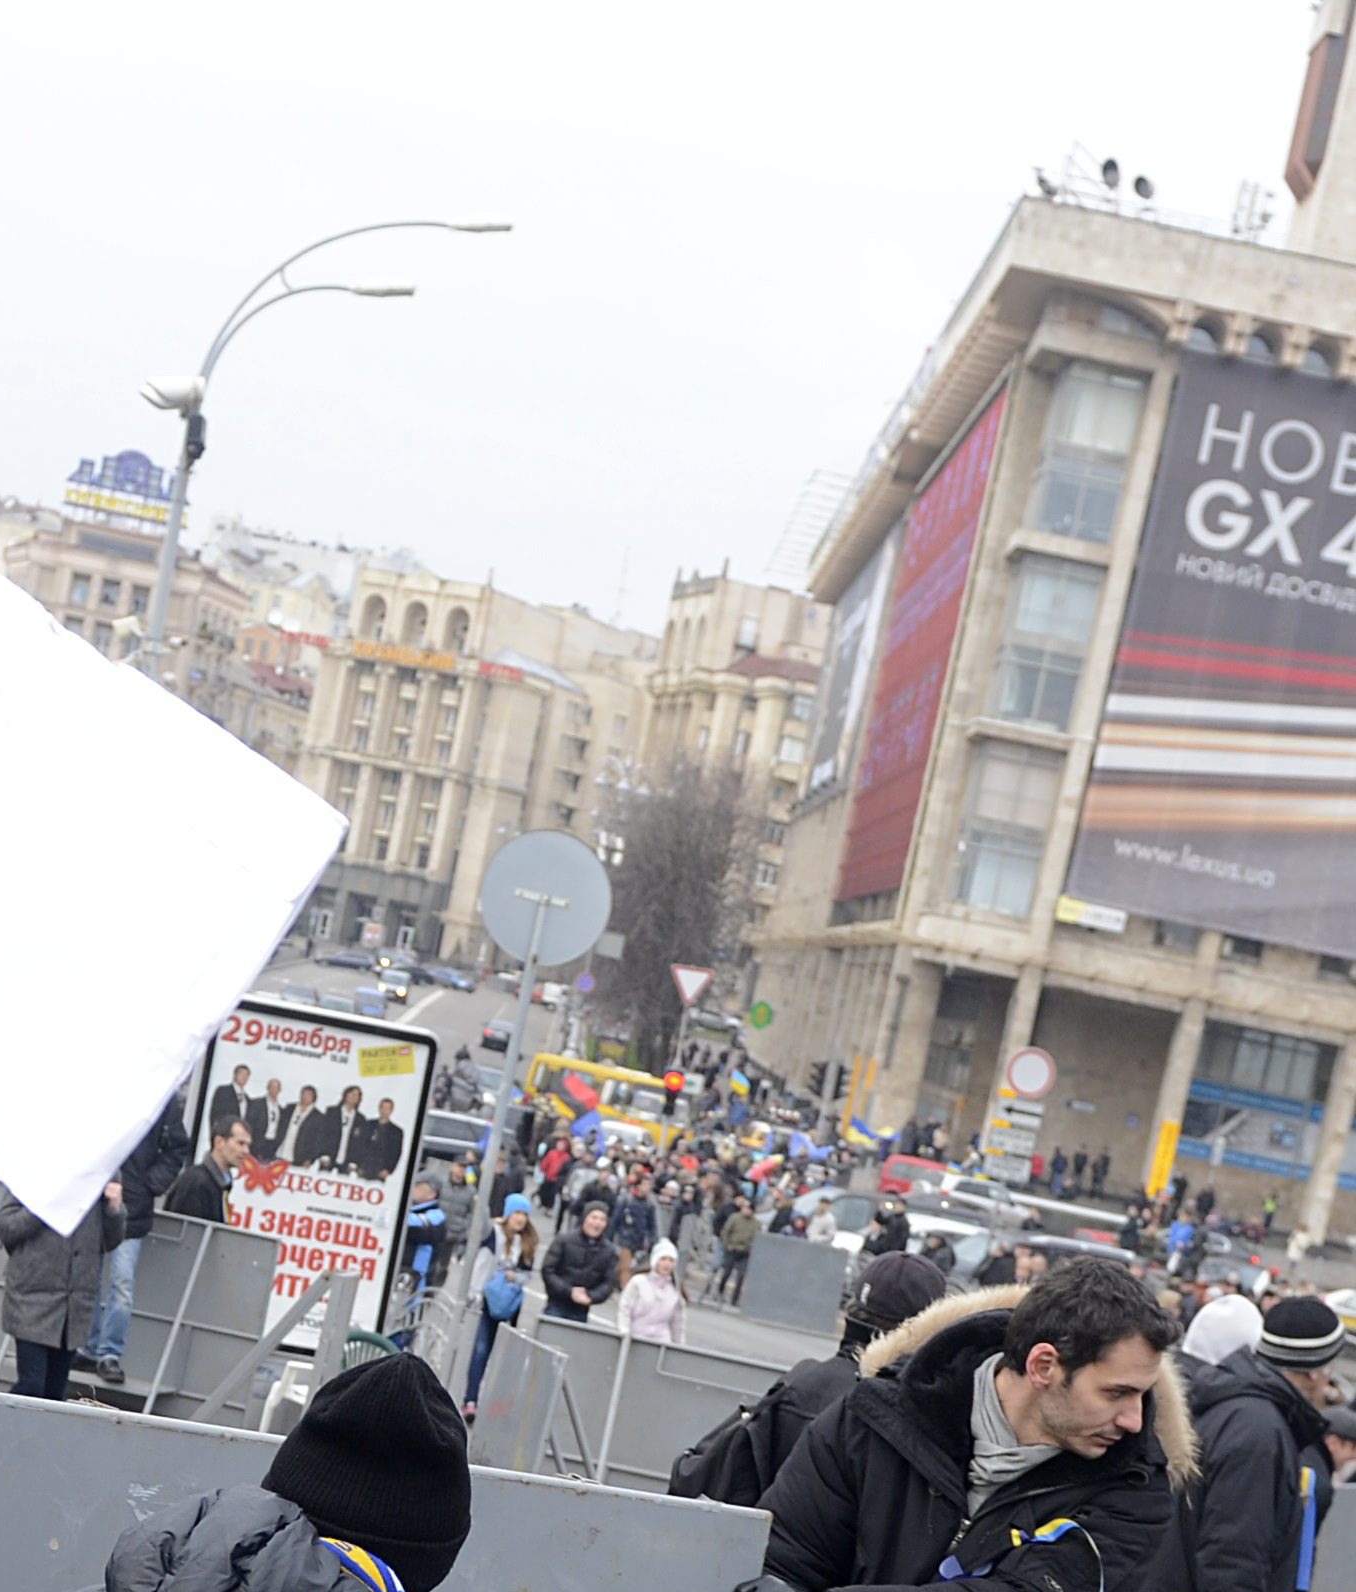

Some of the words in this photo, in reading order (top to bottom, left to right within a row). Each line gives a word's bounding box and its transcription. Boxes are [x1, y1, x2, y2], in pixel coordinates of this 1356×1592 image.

[1184, 478, 1314, 567] GX
[1175, 551, 1265, 592] НОВИЙ
[1113, 837, 1277, 889] www.lexus.ua
[221, 1014, 265, 1047] 29
[265, 1025, 354, 1057] ноября
[228, 1202, 255, 1230] ы
[258, 1207, 386, 1256] знаешь,
